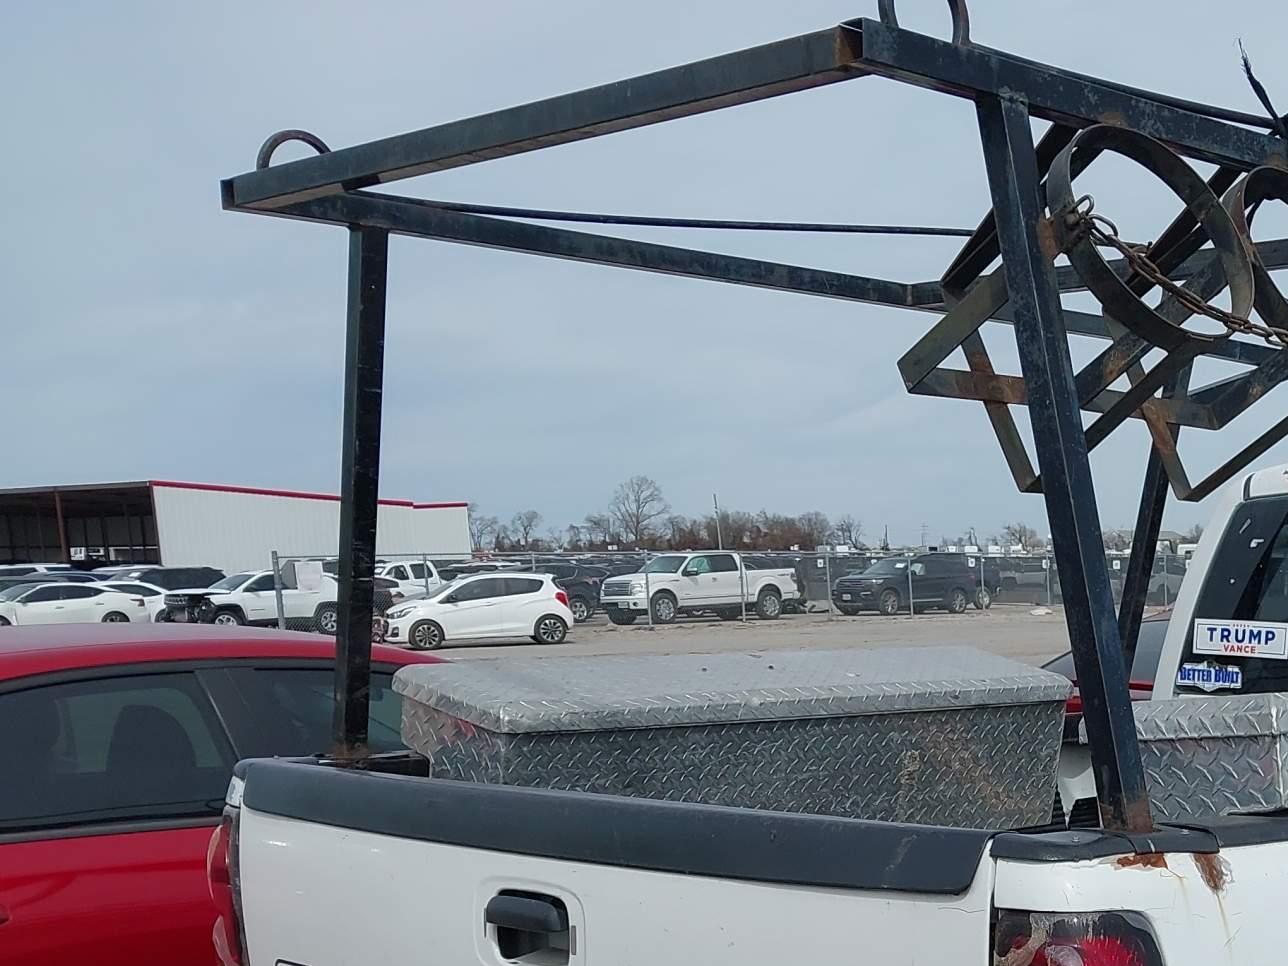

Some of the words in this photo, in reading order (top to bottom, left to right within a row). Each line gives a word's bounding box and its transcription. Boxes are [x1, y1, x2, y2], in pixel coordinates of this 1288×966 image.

[1206, 627, 1276, 645] TRUMP
[1223, 644, 1256, 654] VANCE
[1179, 666, 1212, 681] BETTER
